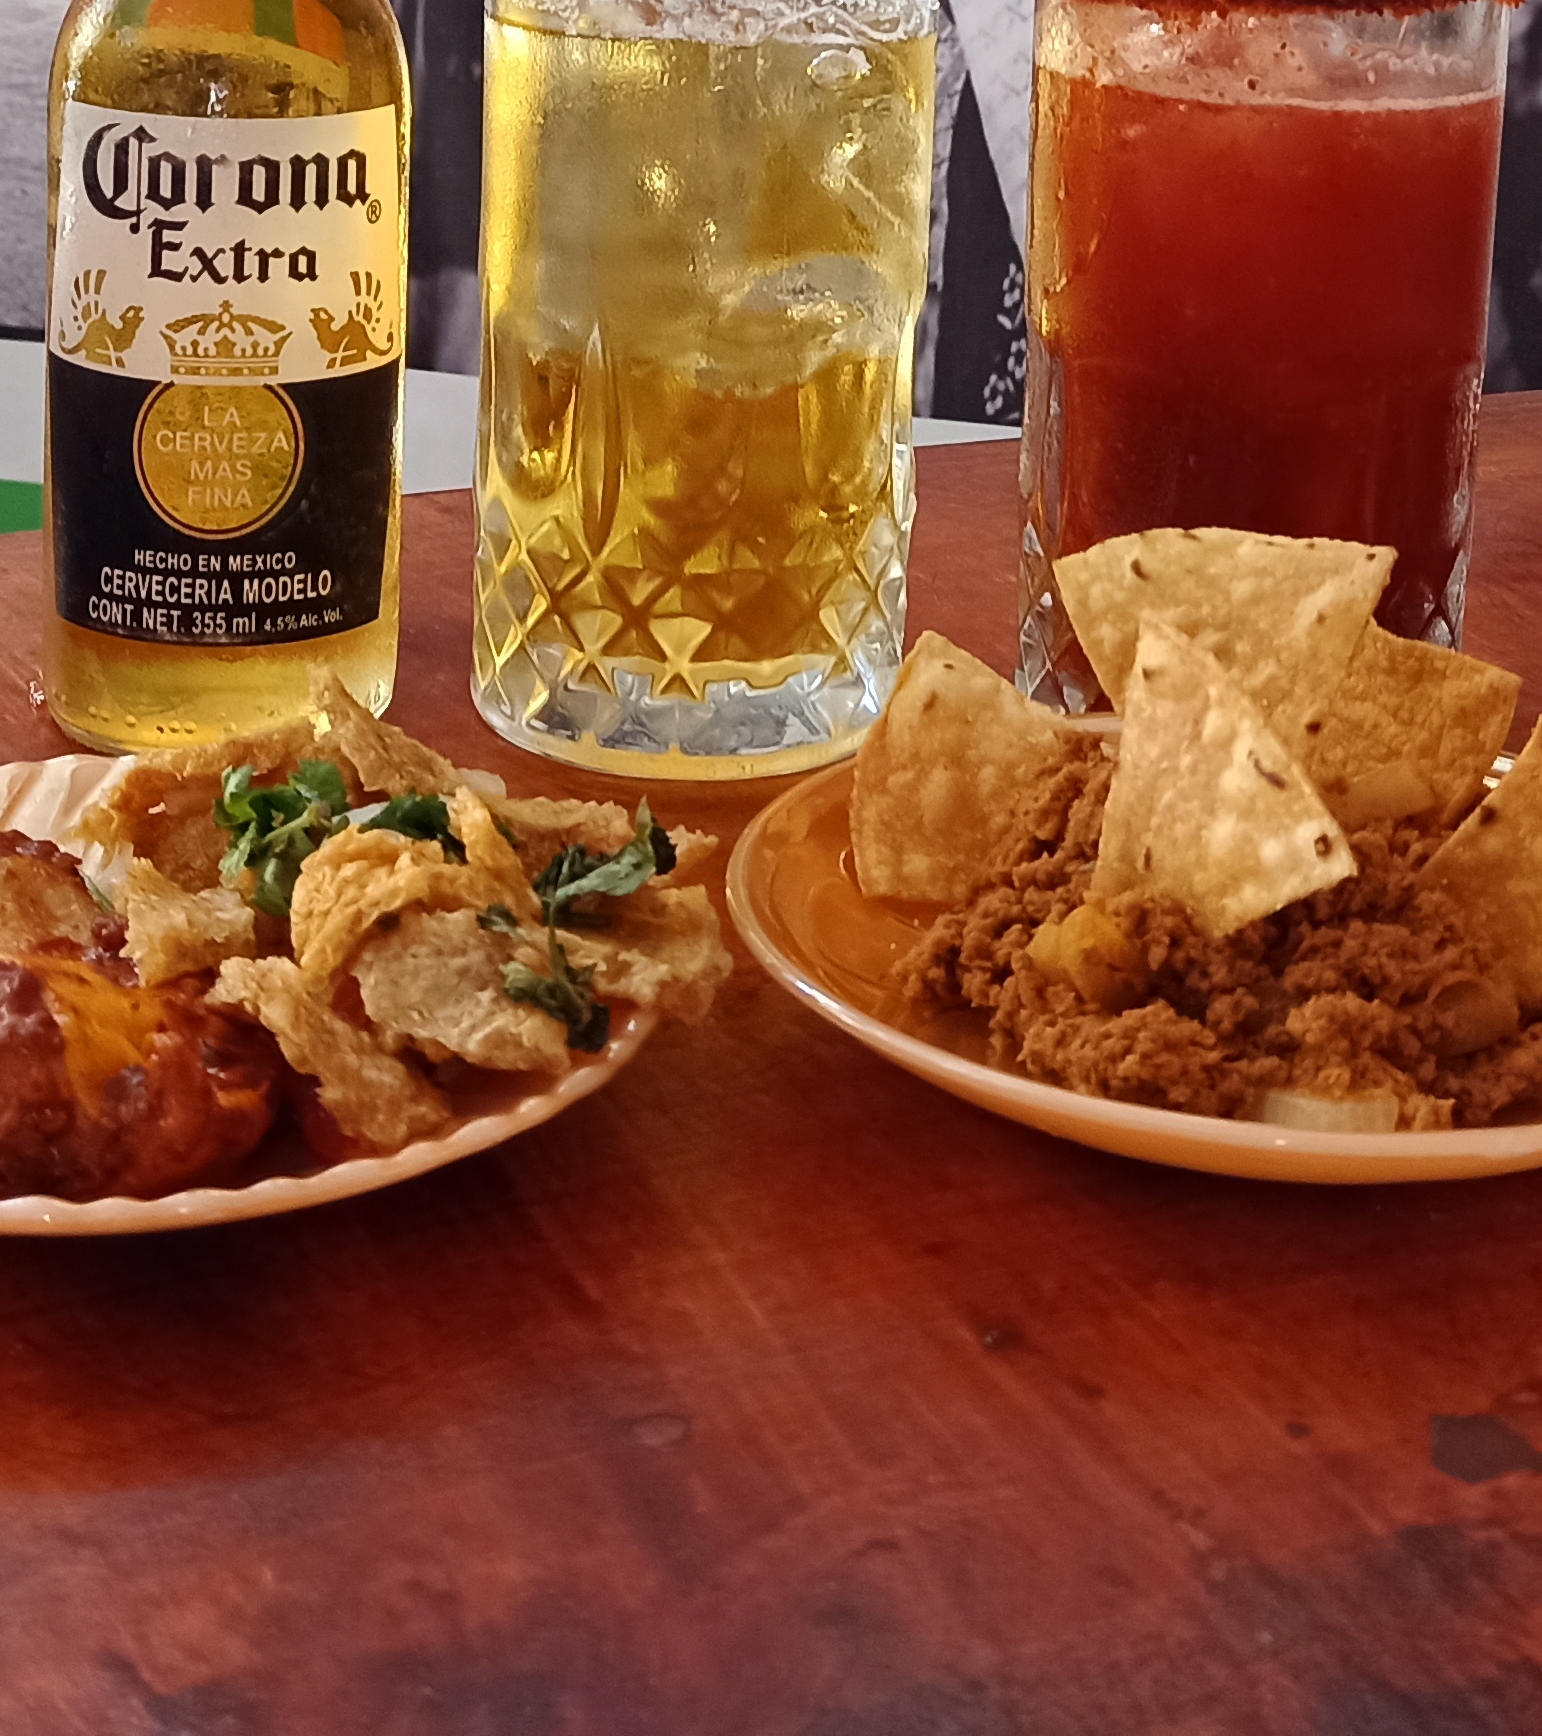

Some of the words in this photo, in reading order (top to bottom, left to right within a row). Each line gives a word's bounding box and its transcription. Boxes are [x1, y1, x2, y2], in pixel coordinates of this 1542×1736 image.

[82, 122, 371, 234] Corona
[147, 217, 319, 284] Extra
[203, 405, 241, 427] LA
[155, 429, 290, 454] CERVEZA
[190, 459, 253, 481] MAS
[188, 486, 253, 508] FINA
[134, 549, 192, 571] HECHO
[198, 554, 221, 572] EN
[228, 551, 296, 572] MEXICO
[100, 566, 233, 605] CERVECERIA
[243, 569, 332, 604] MODELO
[88, 596, 137, 627] CONT.
[143, 607, 185, 633] NET.
[191, 612, 226, 634] 355
[233, 612, 256, 633] ml
